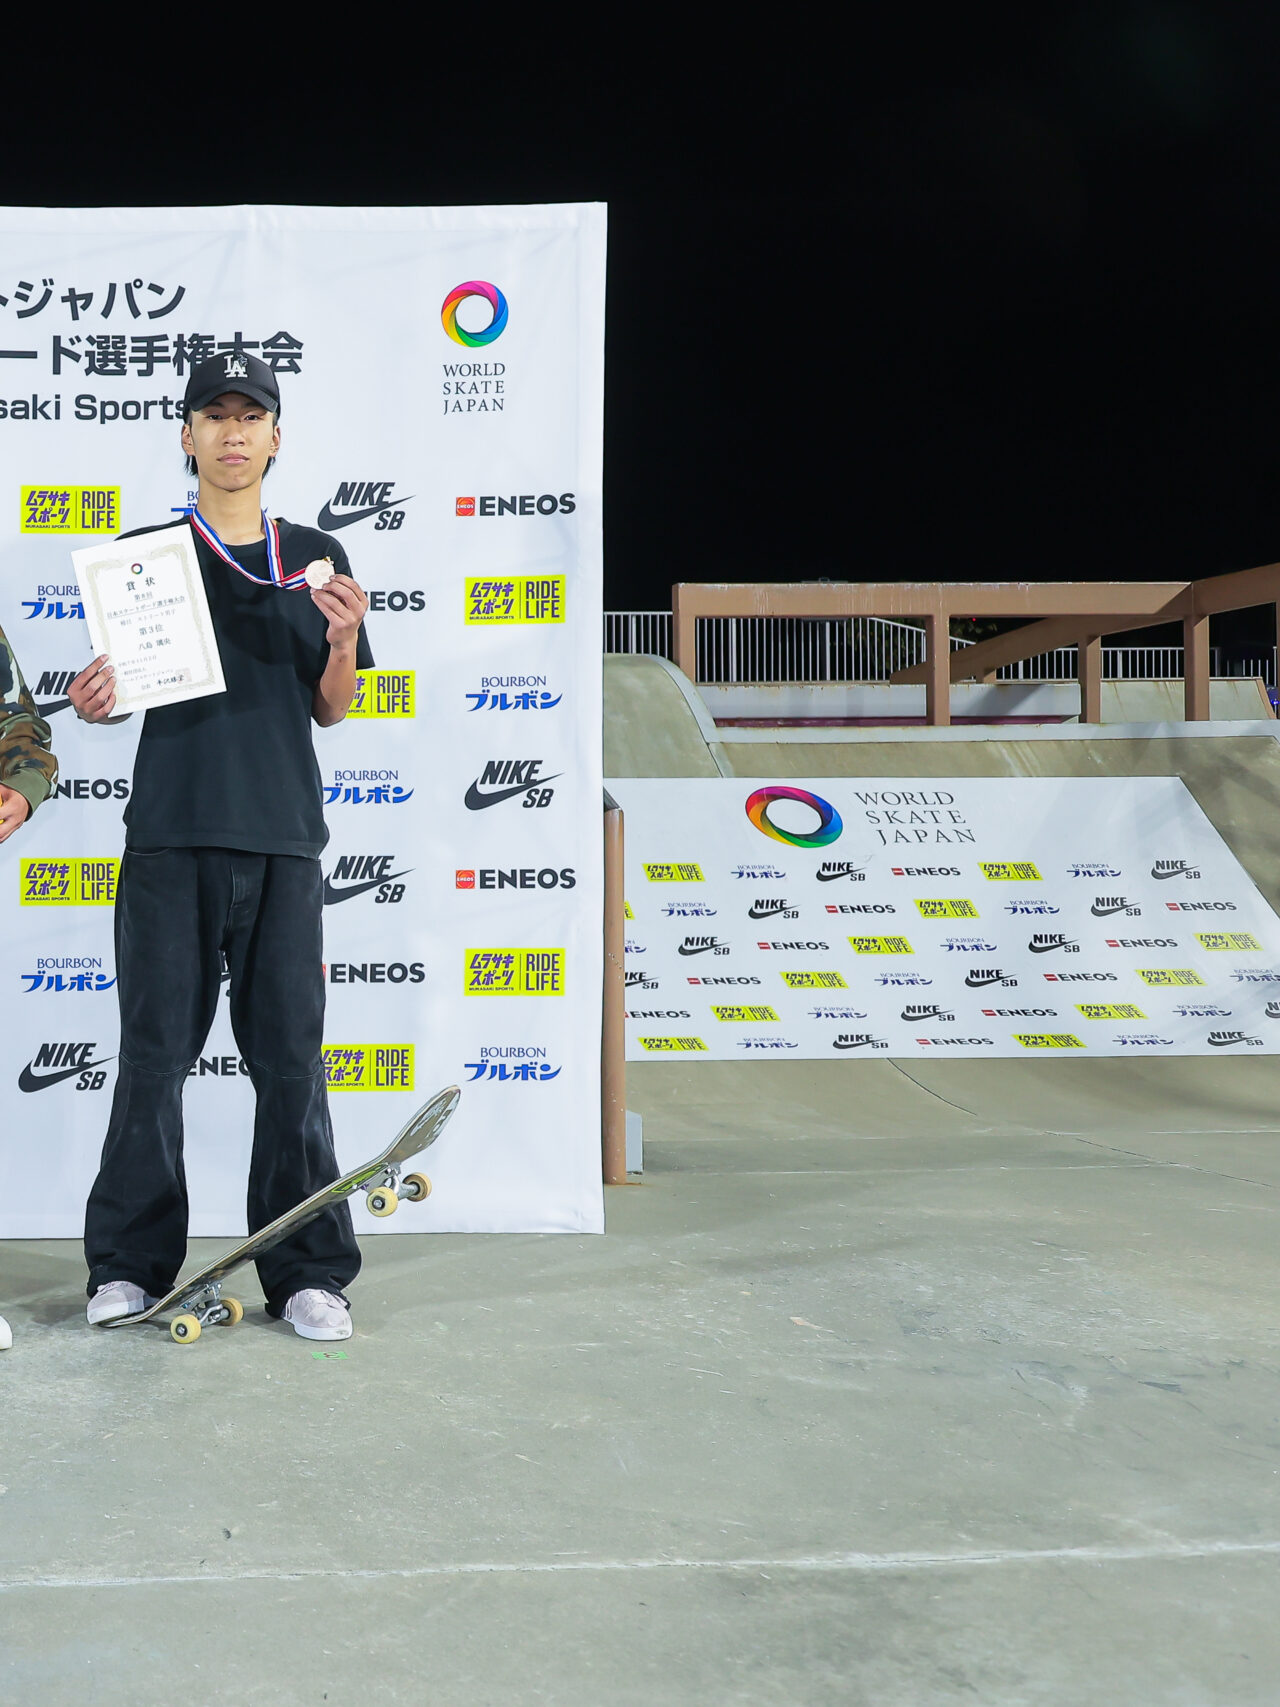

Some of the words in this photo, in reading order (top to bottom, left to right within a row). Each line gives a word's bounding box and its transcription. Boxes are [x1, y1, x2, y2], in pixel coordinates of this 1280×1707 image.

[442, 362, 506, 378] WORLD
[442, 380, 505, 395] SKATE
[74, 393, 186, 424] Sports
[443, 398, 505, 416] JAPAN
[81, 490, 116, 509] RIDE
[332, 481, 396, 507] NIKE
[479, 492, 577, 517] ENEOS
[81, 510, 116, 529] LIFE
[373, 509, 406, 531] SB
[37, 584, 81, 596] BOURB
[525, 579, 561, 600] RIDE
[525, 600, 561, 619] LIFE
[376, 675, 411, 694] RIDE
[481, 675, 547, 688] BOURBON
[376, 694, 411, 713] LIFE
[465, 689, 564, 713] ブルボン
[334, 769, 399, 781] BOURBON
[479, 759, 544, 785] NIKE
[53, 778, 130, 800] NEOS
[323, 782, 415, 805] ブルボン
[522, 787, 555, 809] SB
[853, 791, 955, 806] WORLD
[865, 810, 967, 825] SKATE
[875, 828, 977, 846] JAPAN
[81, 862, 115, 882] RIDE
[332, 855, 395, 880] NIKE
[821, 861, 854, 873] NIKE
[904, 866, 962, 877] ENEOS
[1155, 860, 1188, 871] NIKE
[1185, 870, 1201, 879] SB
[479, 867, 577, 889] ENEOS
[850, 873, 866, 882] SB
[81, 882, 115, 901] LIFE
[374, 883, 407, 904] SB
[753, 898, 788, 910] NIKE
[838, 904, 896, 914] ENEOS
[1181, 901, 1238, 911] ENEOS
[783, 910, 800, 919] SB
[1119, 938, 1178, 949] ENEOS
[37, 957, 102, 969] BOURBON
[525, 952, 561, 972] RIDE
[20, 970, 118, 993] ブルボン
[330, 962, 426, 984] ENEOS
[525, 972, 561, 991] LIFE
[701, 976, 761, 986] ENEOS
[33, 1042, 97, 1068] NIKE
[375, 1048, 410, 1068] RIDE
[480, 1046, 547, 1058] BOURBON
[375, 1068, 410, 1087] LIFE
[464, 1059, 563, 1082] ブルボン
[75, 1070, 108, 1091] SB
